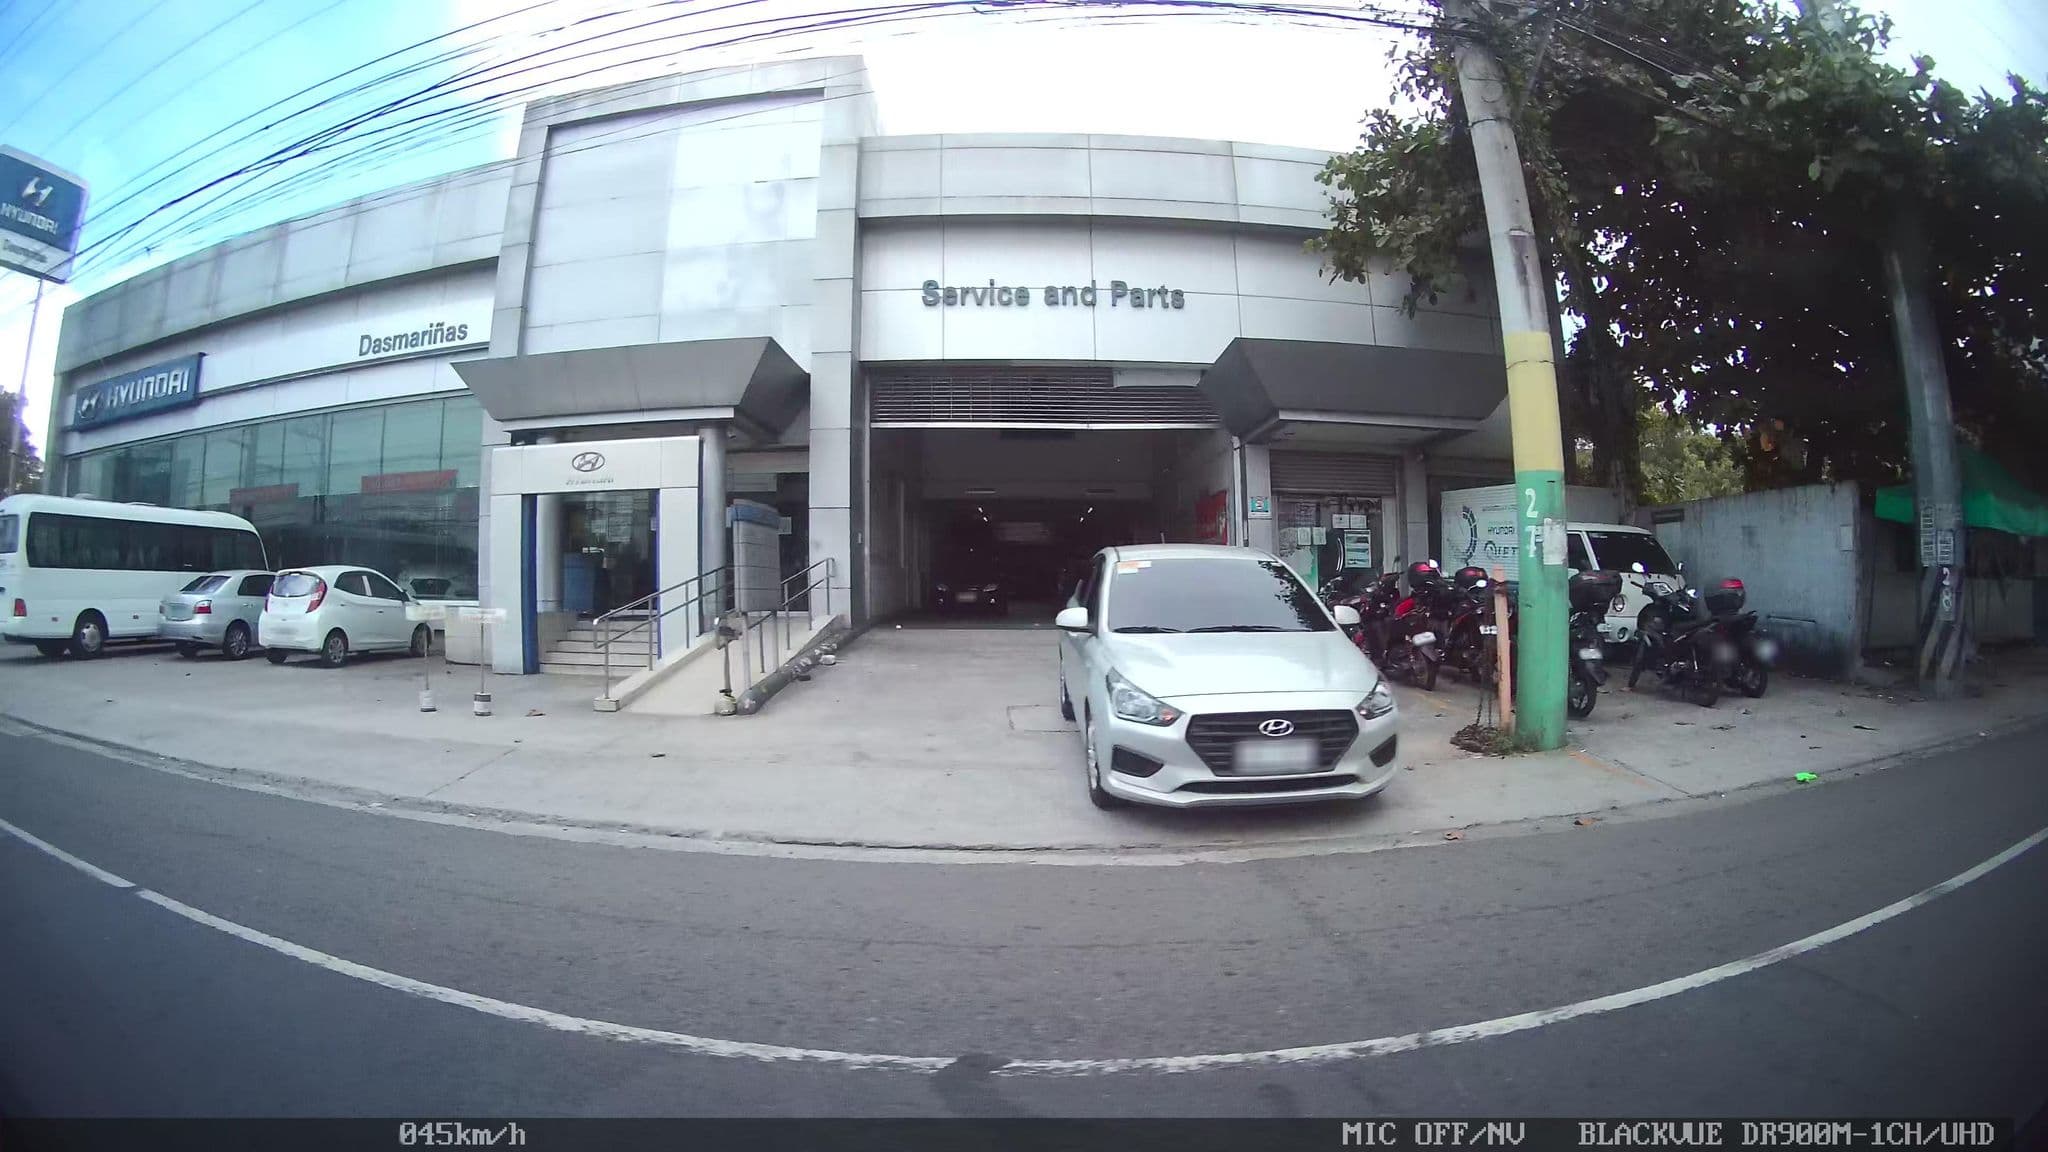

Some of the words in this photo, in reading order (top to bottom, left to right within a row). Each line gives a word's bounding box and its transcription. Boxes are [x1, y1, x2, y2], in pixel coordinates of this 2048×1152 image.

[922, 279, 1030, 307] Service
[1043, 280, 1097, 307] and
[1111, 280, 1185, 309] Parts
[359, 321, 468, 356] Dasmariñas
[105, 367, 190, 408] HYUNDAI
